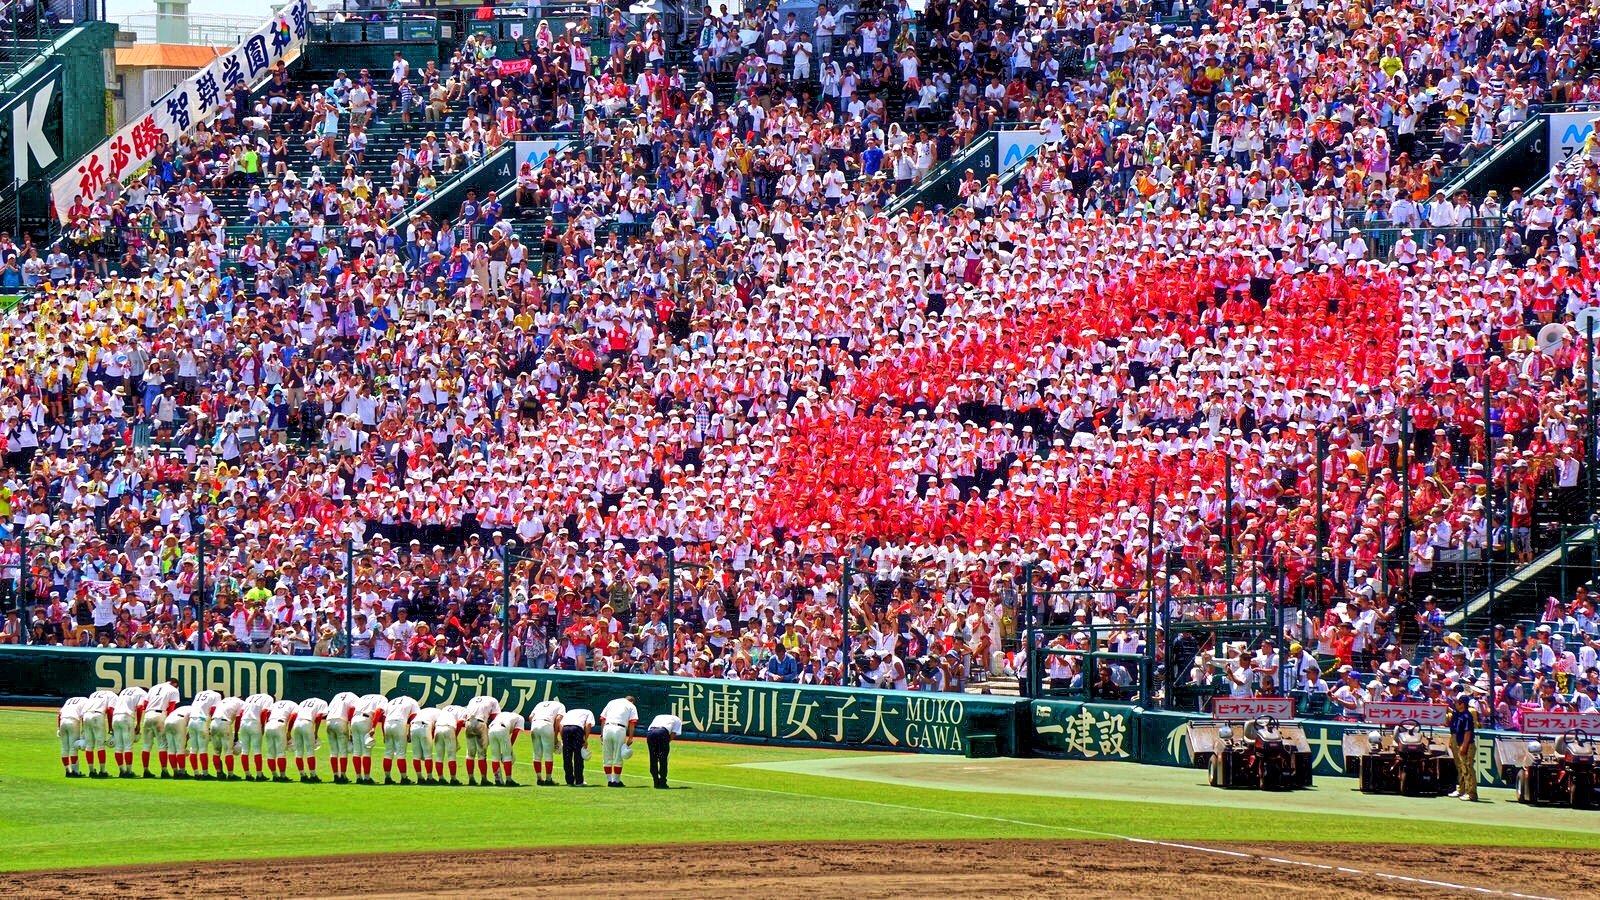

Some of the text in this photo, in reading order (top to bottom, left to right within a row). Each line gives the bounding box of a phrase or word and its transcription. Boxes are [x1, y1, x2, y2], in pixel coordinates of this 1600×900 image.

[13, 79, 57, 191] K
[95, 655, 284, 701] SHIMANO
[155, 687, 162, 696] 1
[196, 693, 209, 702] 15
[906, 697, 964, 724] MUKO
[1218, 704, 1289, 714] ビオフェルミン
[668, 682, 899, 746] 武庫川女子大
[1368, 708, 1443, 719] ビオフェルミン
[906, 723, 962, 750] GAWA
[1036, 706, 1130, 757] 一建設
[1307, 728, 1344, 773] 大
